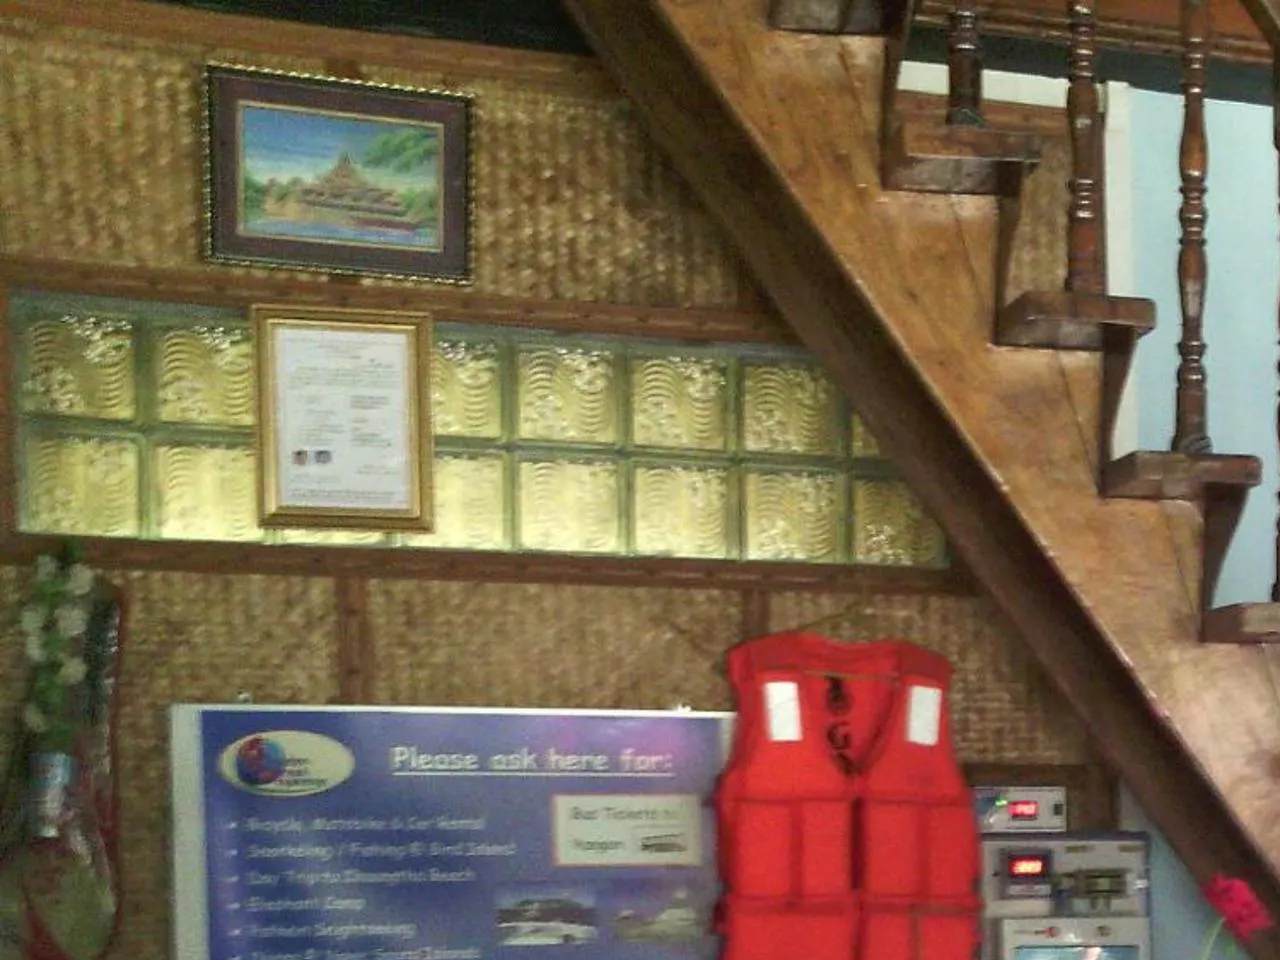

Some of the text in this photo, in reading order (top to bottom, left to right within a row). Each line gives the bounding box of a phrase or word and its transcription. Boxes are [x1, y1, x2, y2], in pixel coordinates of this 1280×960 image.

[391, 745, 673, 771] Please ask here for:
